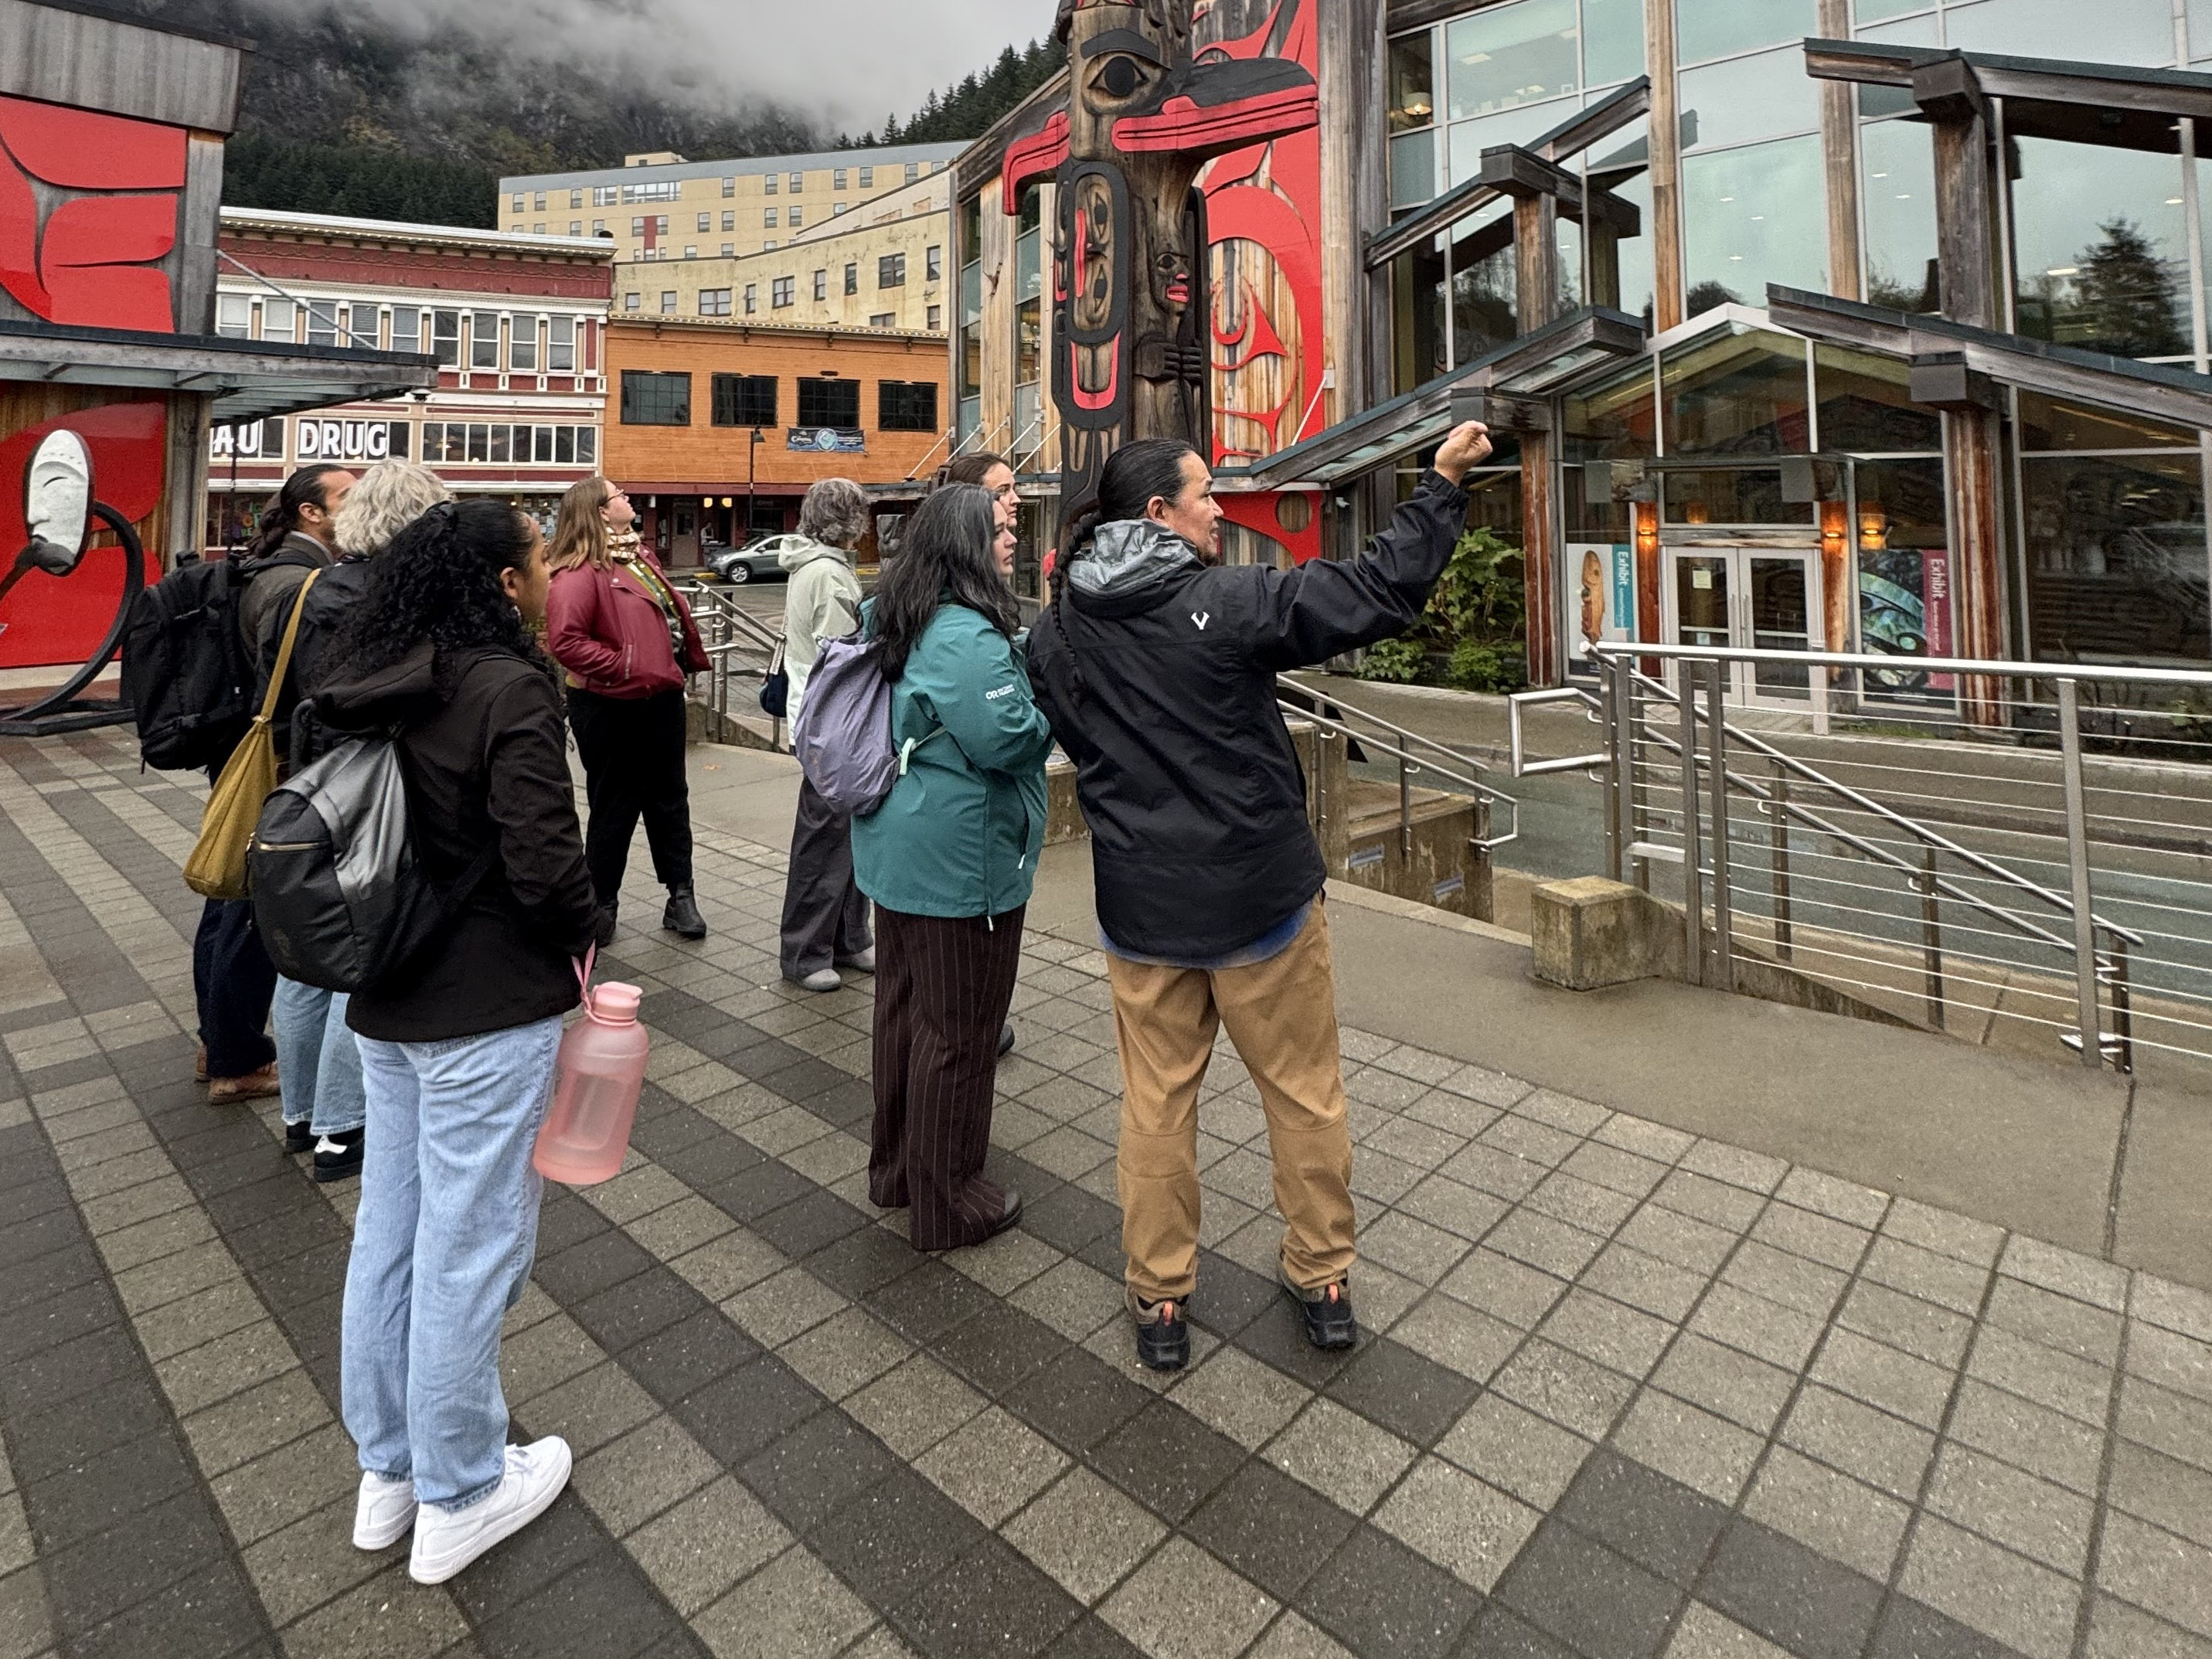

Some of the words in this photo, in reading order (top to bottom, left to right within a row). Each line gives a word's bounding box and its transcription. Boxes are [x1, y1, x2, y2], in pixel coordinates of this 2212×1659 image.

[299, 422, 386, 457] DRUG
[1618, 551, 1630, 586] Exhibit
[1930, 559, 1947, 600] Exhibit
